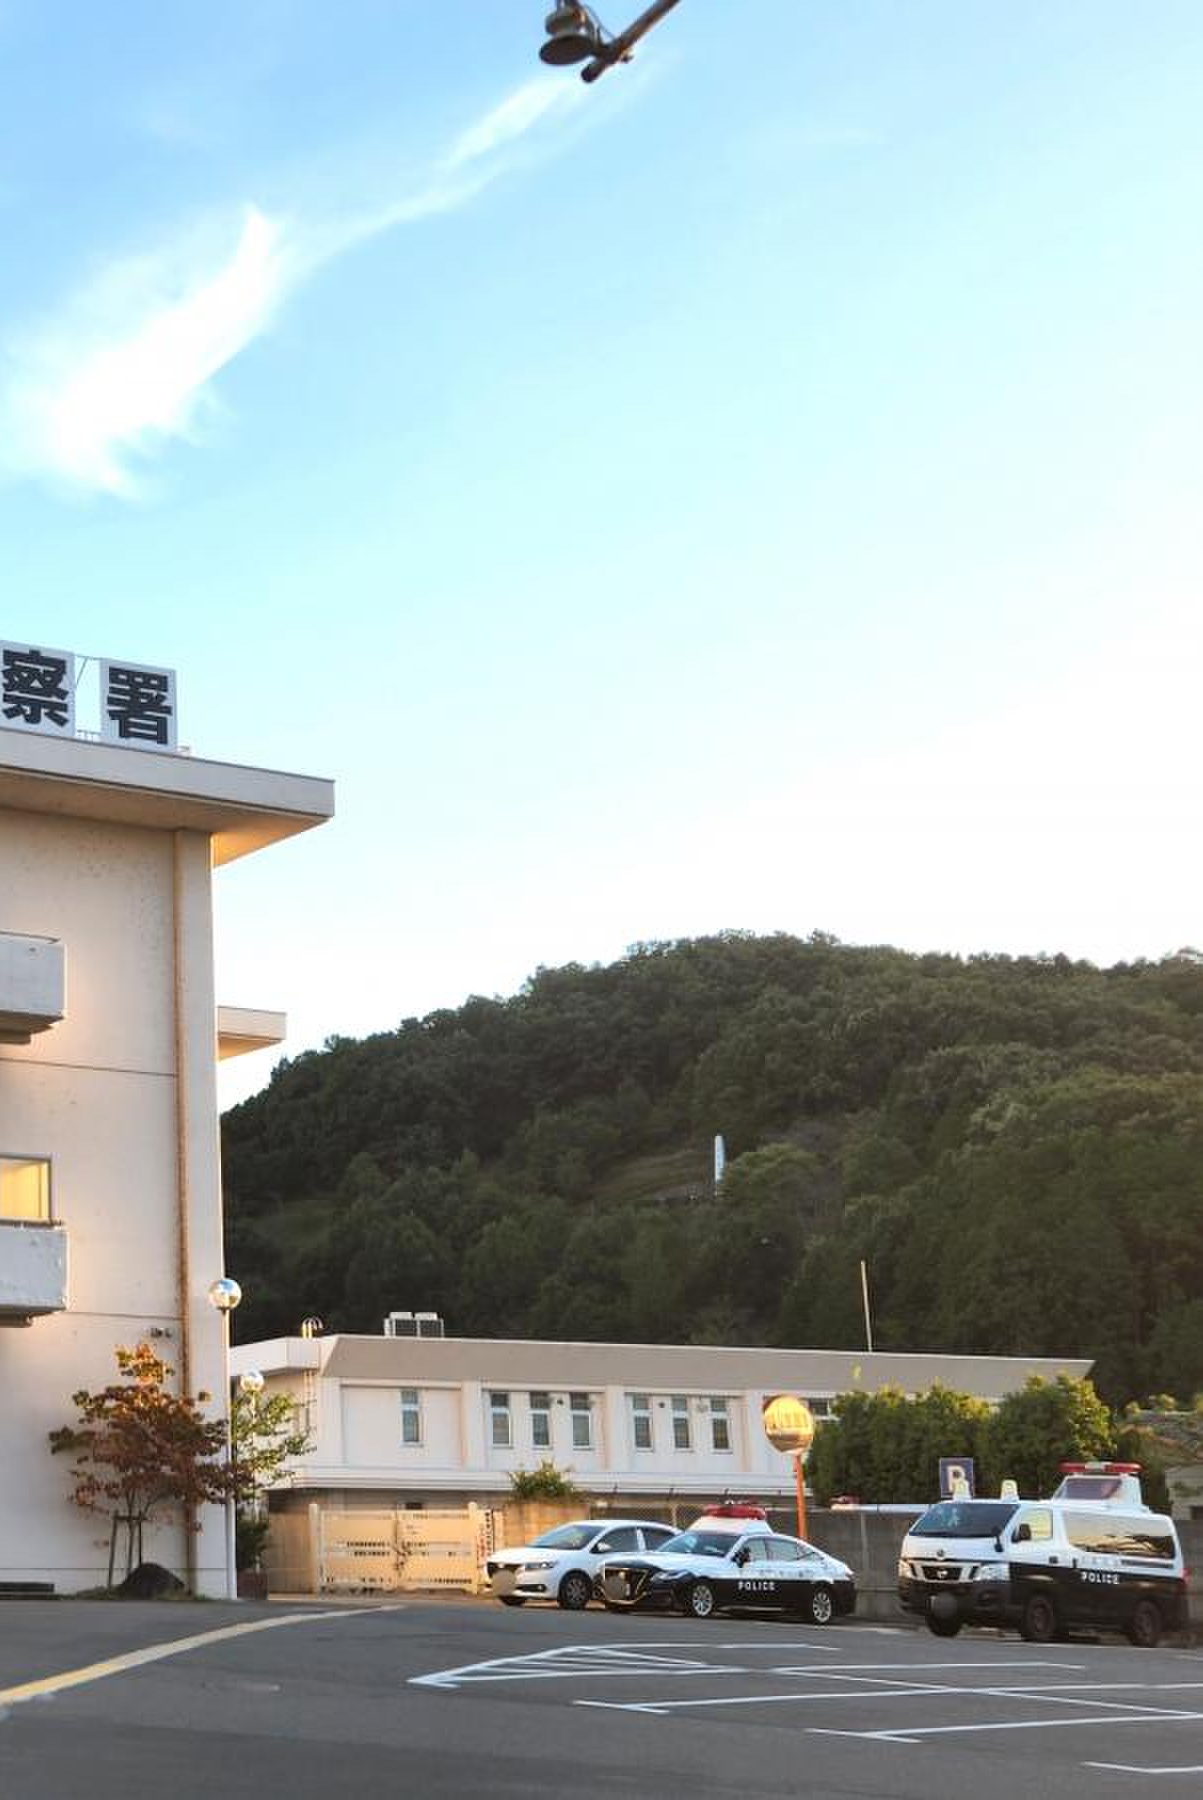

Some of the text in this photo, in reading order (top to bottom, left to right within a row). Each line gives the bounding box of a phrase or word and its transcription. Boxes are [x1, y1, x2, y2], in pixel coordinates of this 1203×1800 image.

[947, 1465, 966, 1493] P
[1081, 1571, 1120, 1585] POLICE
[738, 1581, 776, 1591] POLICE
